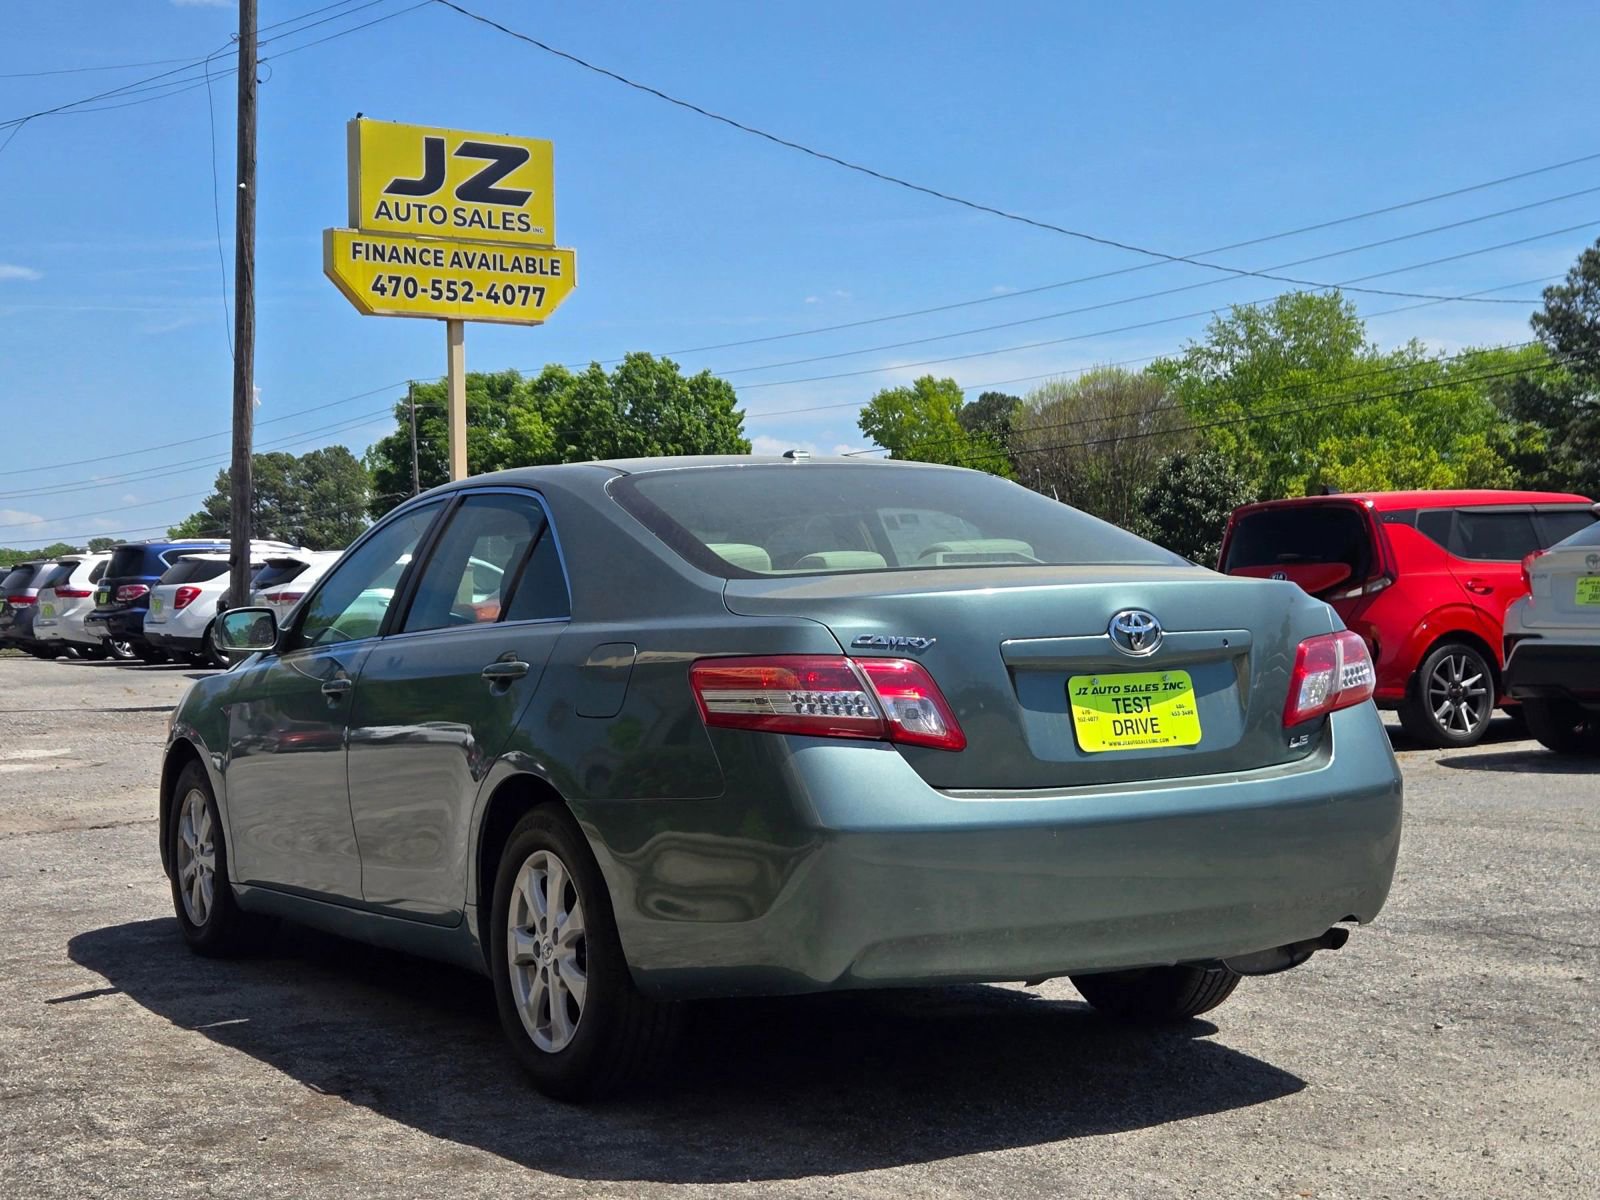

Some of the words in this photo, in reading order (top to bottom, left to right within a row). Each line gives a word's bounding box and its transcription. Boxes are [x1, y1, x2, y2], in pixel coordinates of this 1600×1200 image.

[383, 137, 533, 207] JZ
[374, 200, 447, 225] AUTO
[453, 207, 531, 233] SALES
[351, 242, 444, 267] FINANCE
[450, 251, 561, 276] AVAILABLE
[371, 275, 546, 307] 470-552-4077
[851, 633, 937, 650] CAMRY
[1075, 687, 1088, 696] JZ
[1091, 686, 1121, 695] AUTO
[1123, 683, 1159, 694] SALES
[1162, 681, 1187, 691] INC.
[1112, 696, 1152, 714] TEST
[1112, 717, 1161, 736] DRIVE
[1289, 734, 1310, 748] LE
